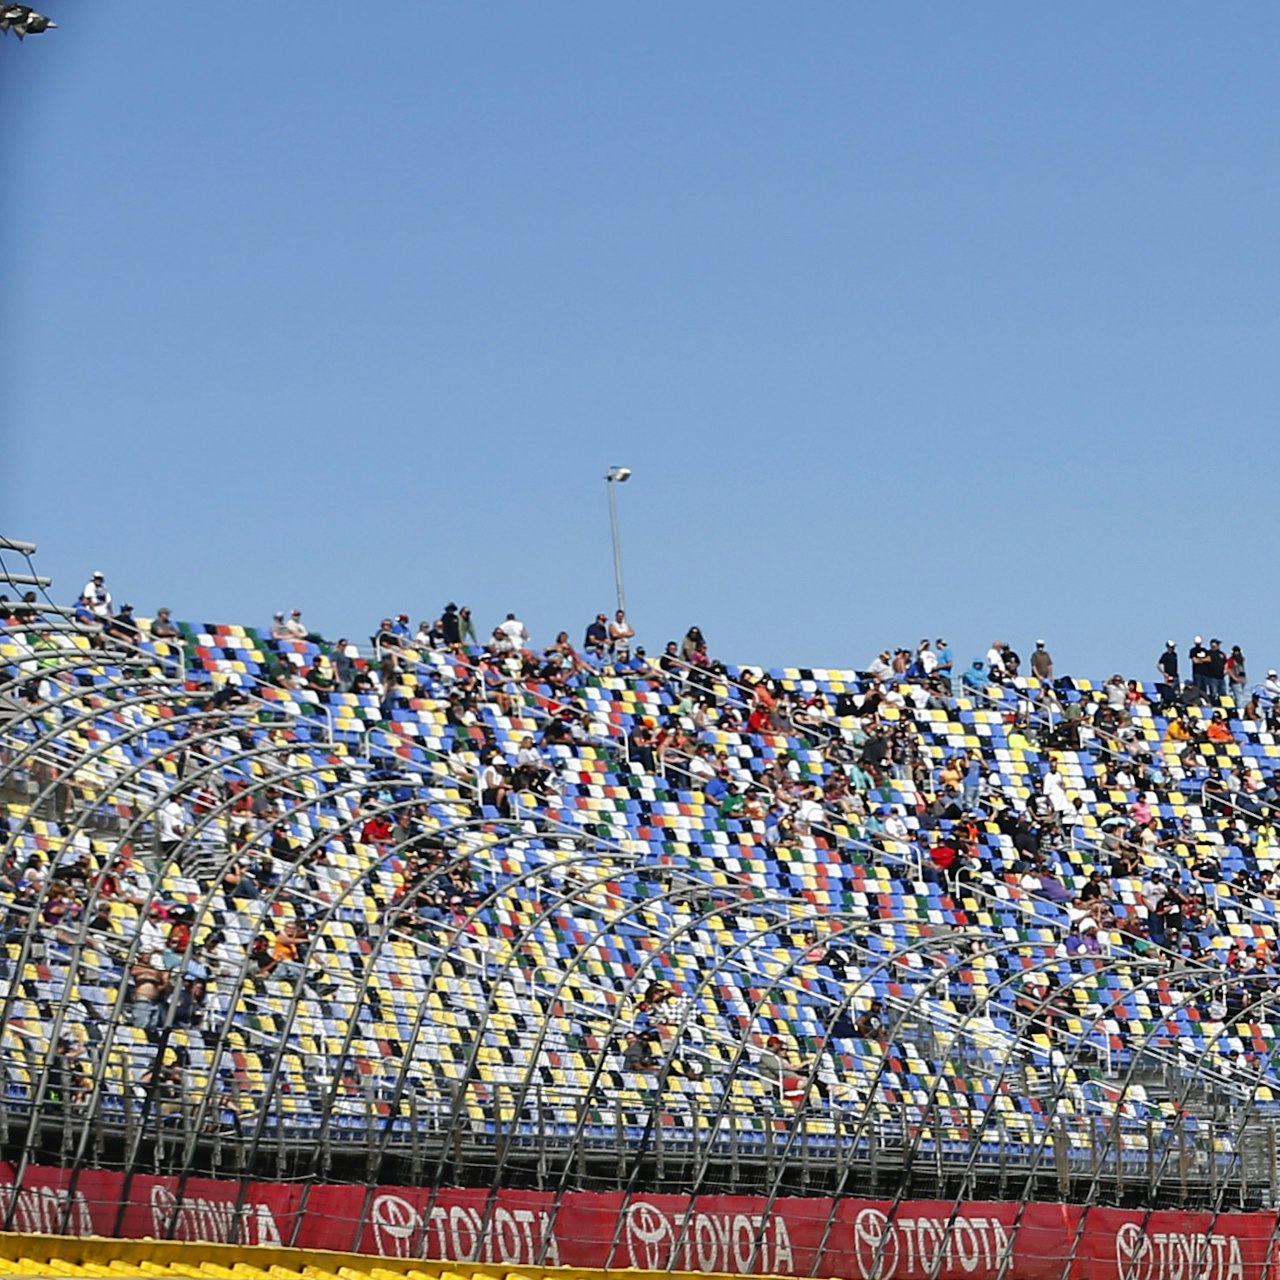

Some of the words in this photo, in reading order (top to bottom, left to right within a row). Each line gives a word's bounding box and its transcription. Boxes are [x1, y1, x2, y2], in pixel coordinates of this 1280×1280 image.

[424, 1207, 559, 1266] TOYOTA
[674, 1215, 794, 1274] TOYOTA
[899, 1217, 1014, 1271] TOYOTA
